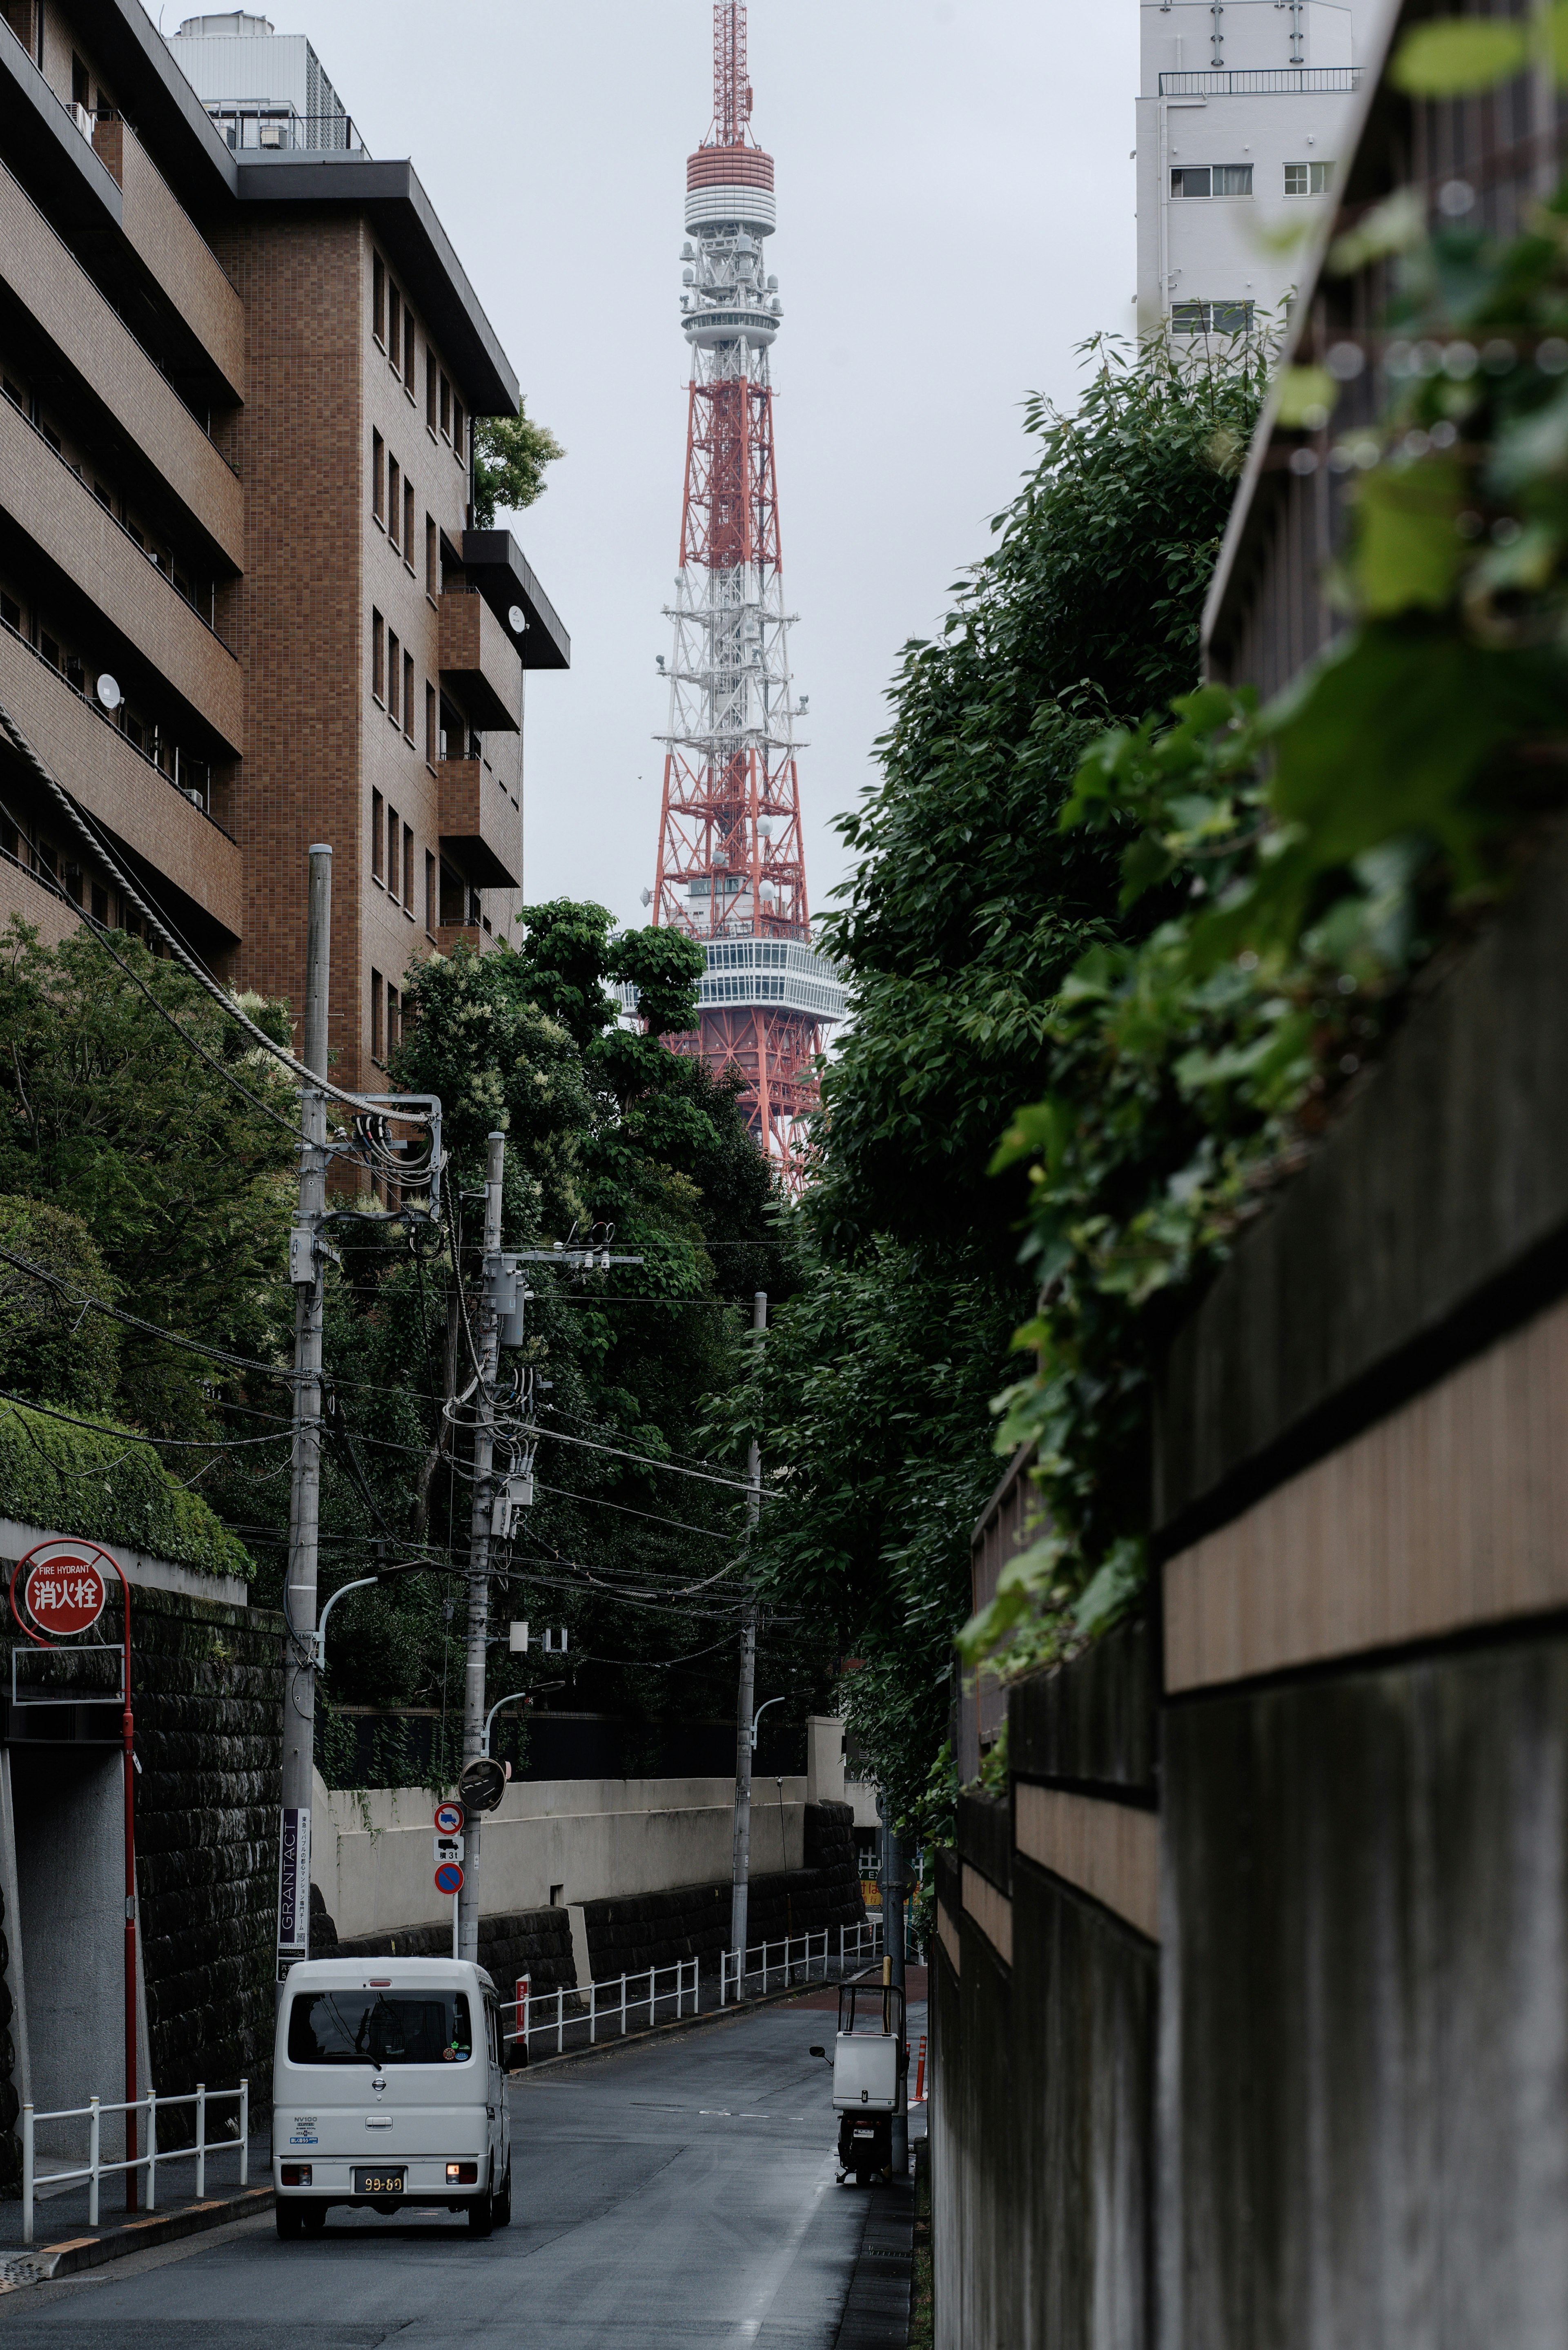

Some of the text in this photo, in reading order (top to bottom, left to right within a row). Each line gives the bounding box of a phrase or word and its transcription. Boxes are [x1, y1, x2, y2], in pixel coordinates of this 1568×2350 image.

[39, 1565, 90, 1575] FIRE HYDRANT
[34, 1578, 98, 1610] 消火栓
[282, 1821, 296, 1930] GRANTACT
